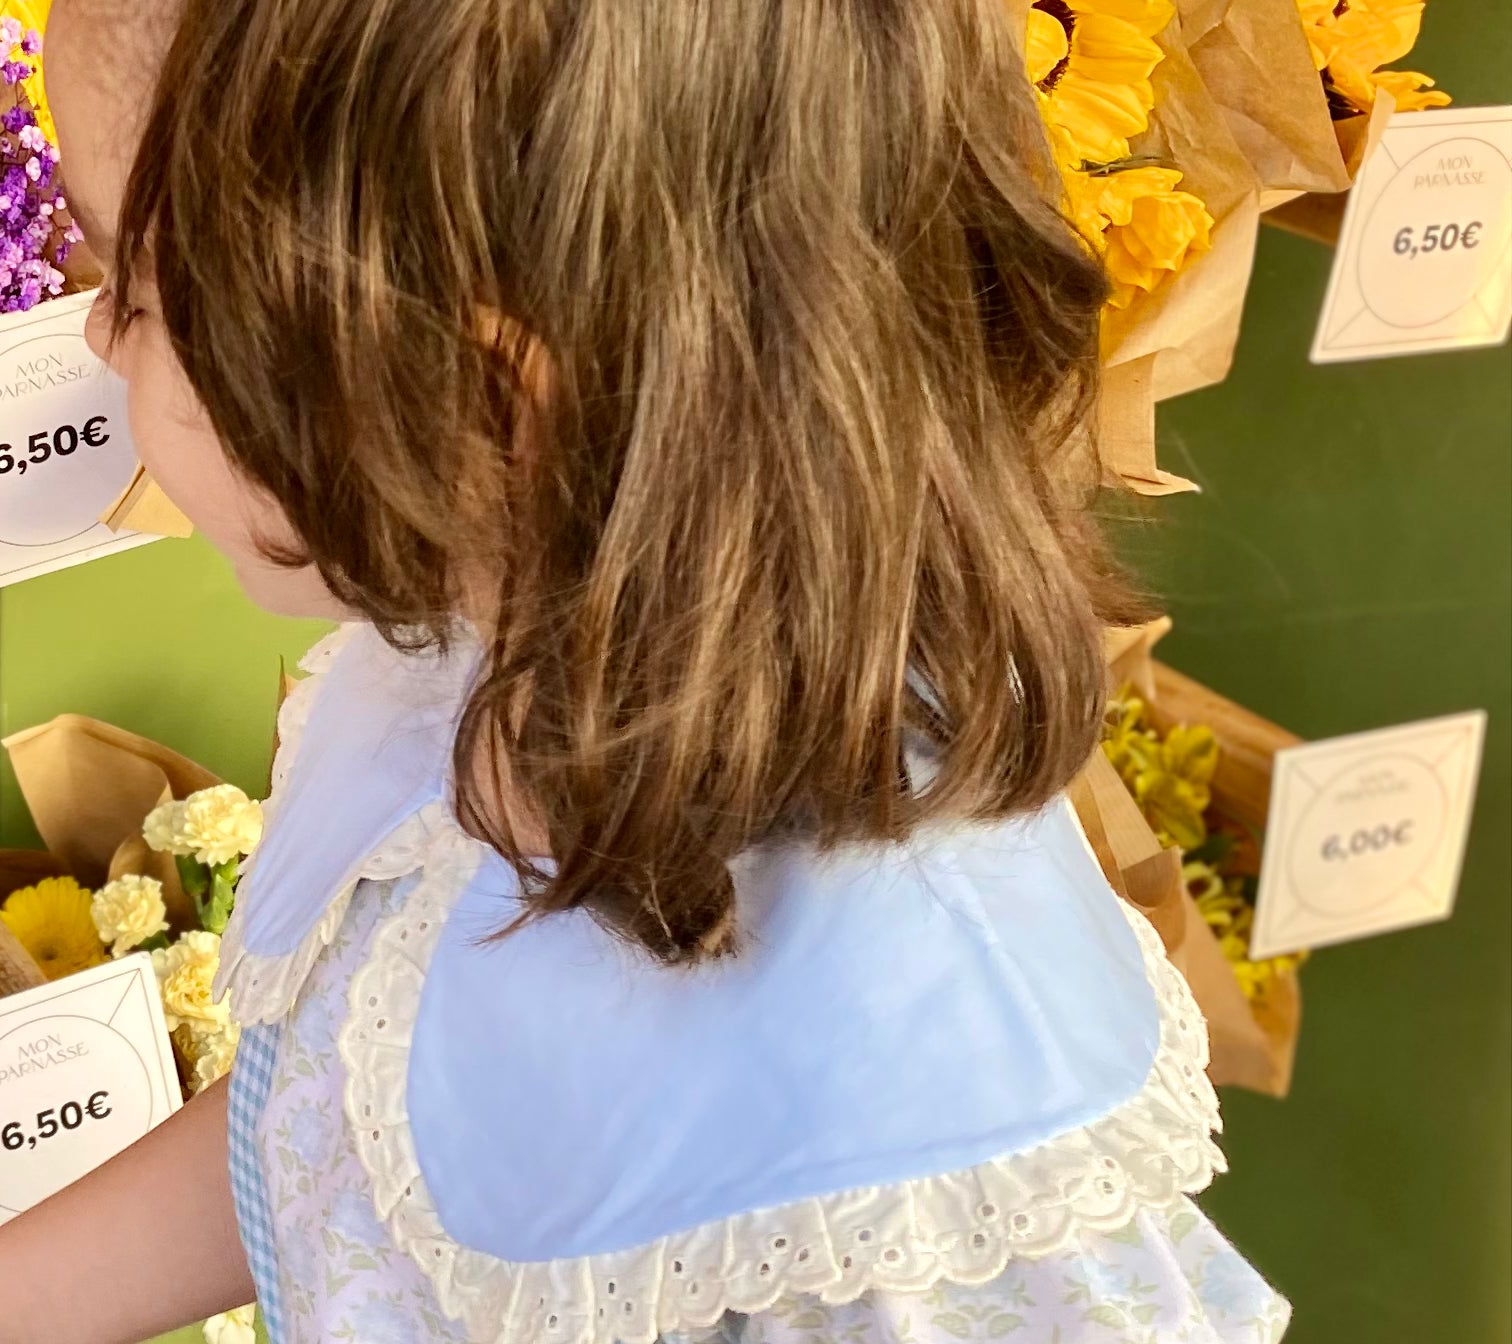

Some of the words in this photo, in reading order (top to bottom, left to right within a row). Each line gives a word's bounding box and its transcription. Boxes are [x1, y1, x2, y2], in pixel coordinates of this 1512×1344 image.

[1392, 221, 1483, 260] 6,50€
[16, 351, 64, 379] MON
[18, 1032, 63, 1061] MON
[0, 1090, 113, 1151] 6,50€
